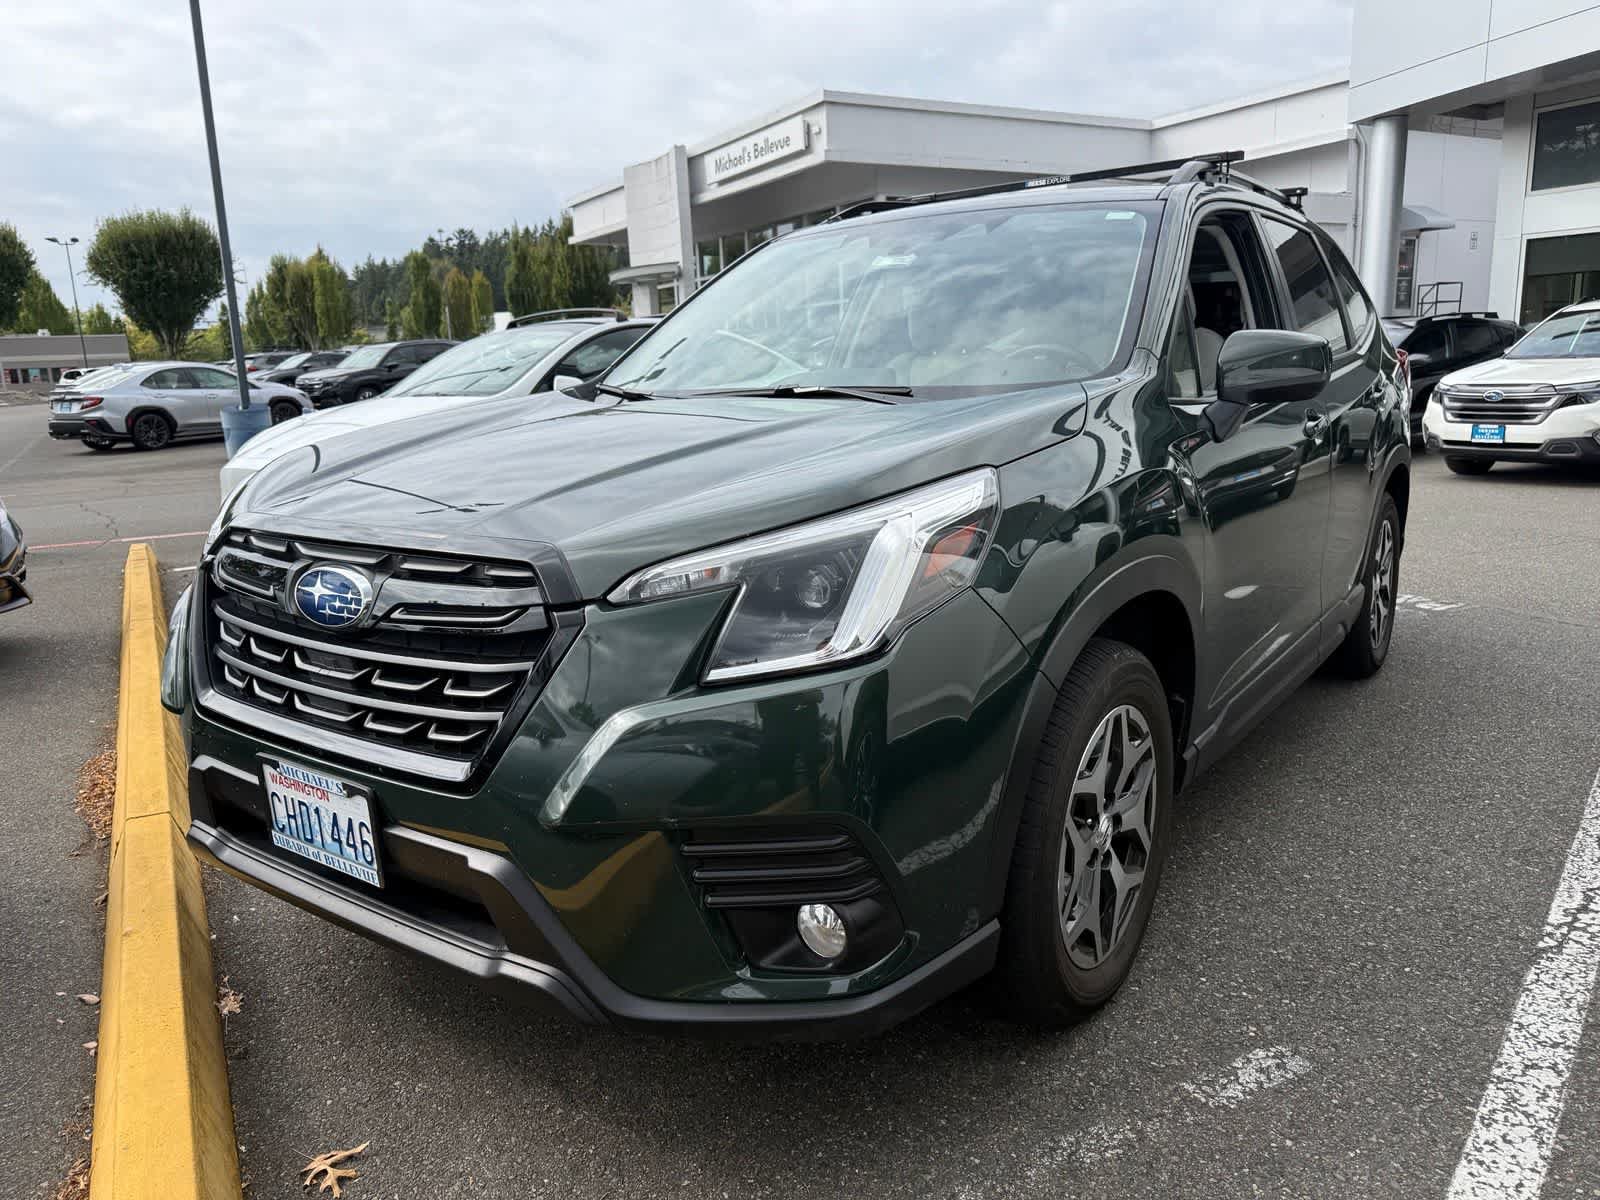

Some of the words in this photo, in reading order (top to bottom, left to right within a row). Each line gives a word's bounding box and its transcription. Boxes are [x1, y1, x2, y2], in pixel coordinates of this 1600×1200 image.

[715, 146, 751, 175] Michael's
[753, 136, 791, 159] Bellevue
[269, 772, 330, 802] WASHINGTON
[280, 764, 343, 794] MICHAEL'S
[270, 791, 375, 866] CHD1446
[273, 833, 311, 857] SUBARU
[312, 850, 321, 861] of
[323, 855, 379, 885] BELLEVUE
